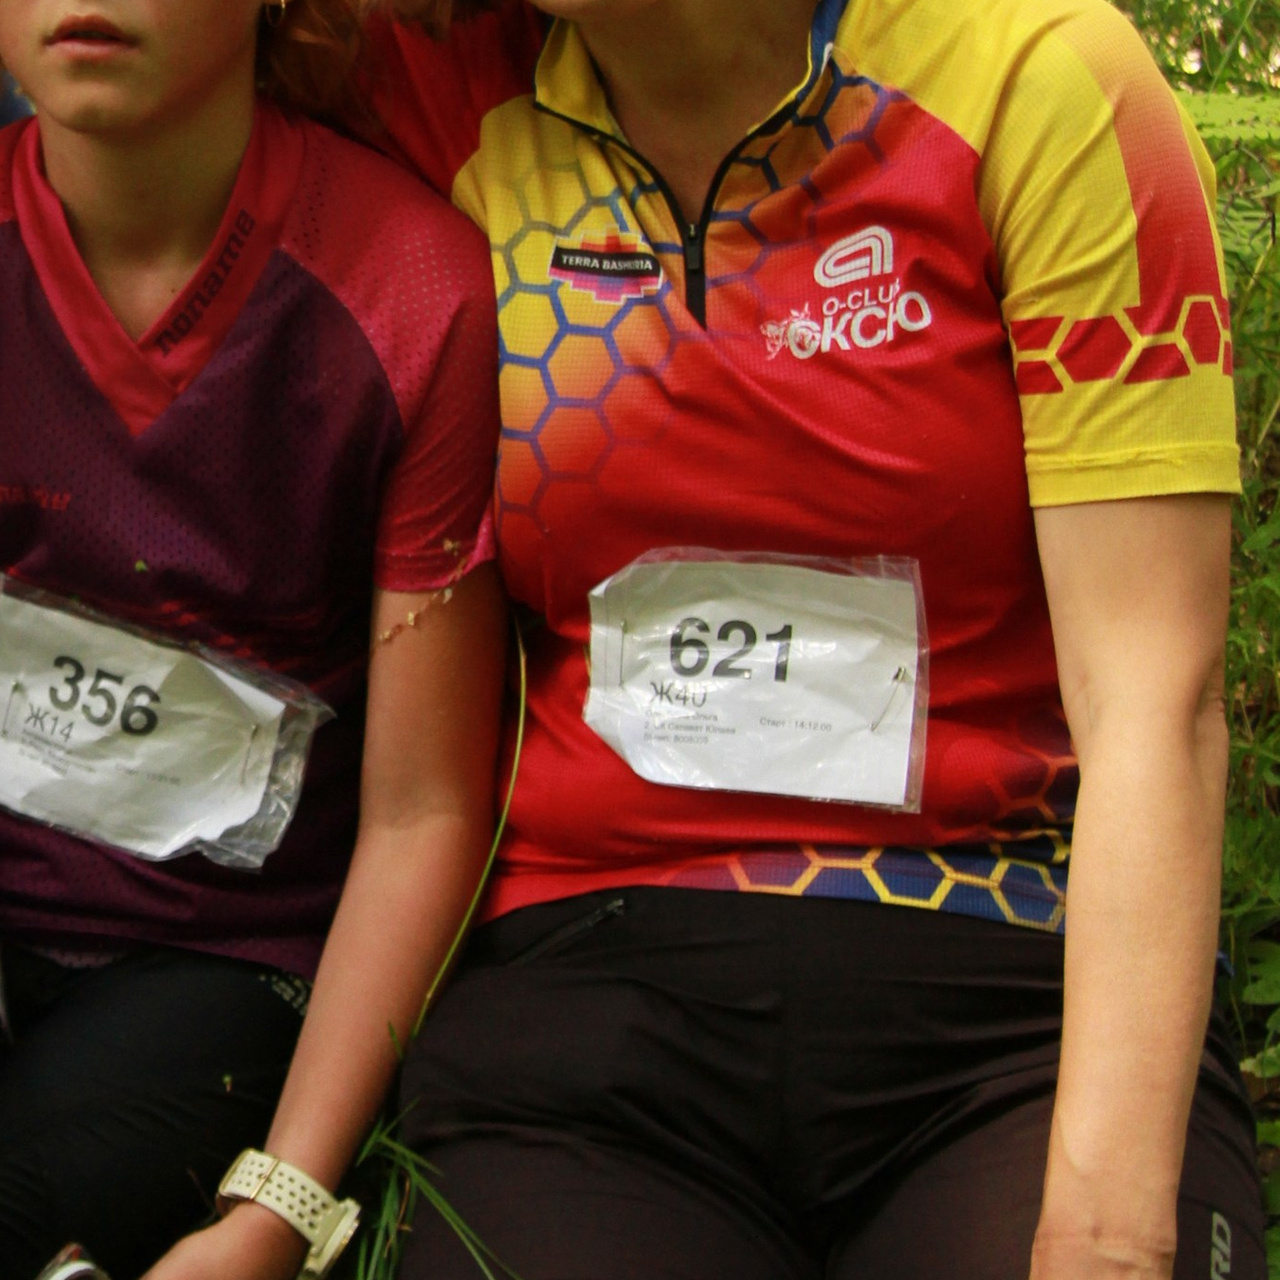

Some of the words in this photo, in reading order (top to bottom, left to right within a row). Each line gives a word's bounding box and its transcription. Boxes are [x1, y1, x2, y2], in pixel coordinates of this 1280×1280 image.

[154, 208, 257, 357] noname
[561, 254, 600, 270] TERRA
[669, 617, 793, 683] 621
[24, 704, 76, 743] Ж14
[48, 655, 162, 736] 356
